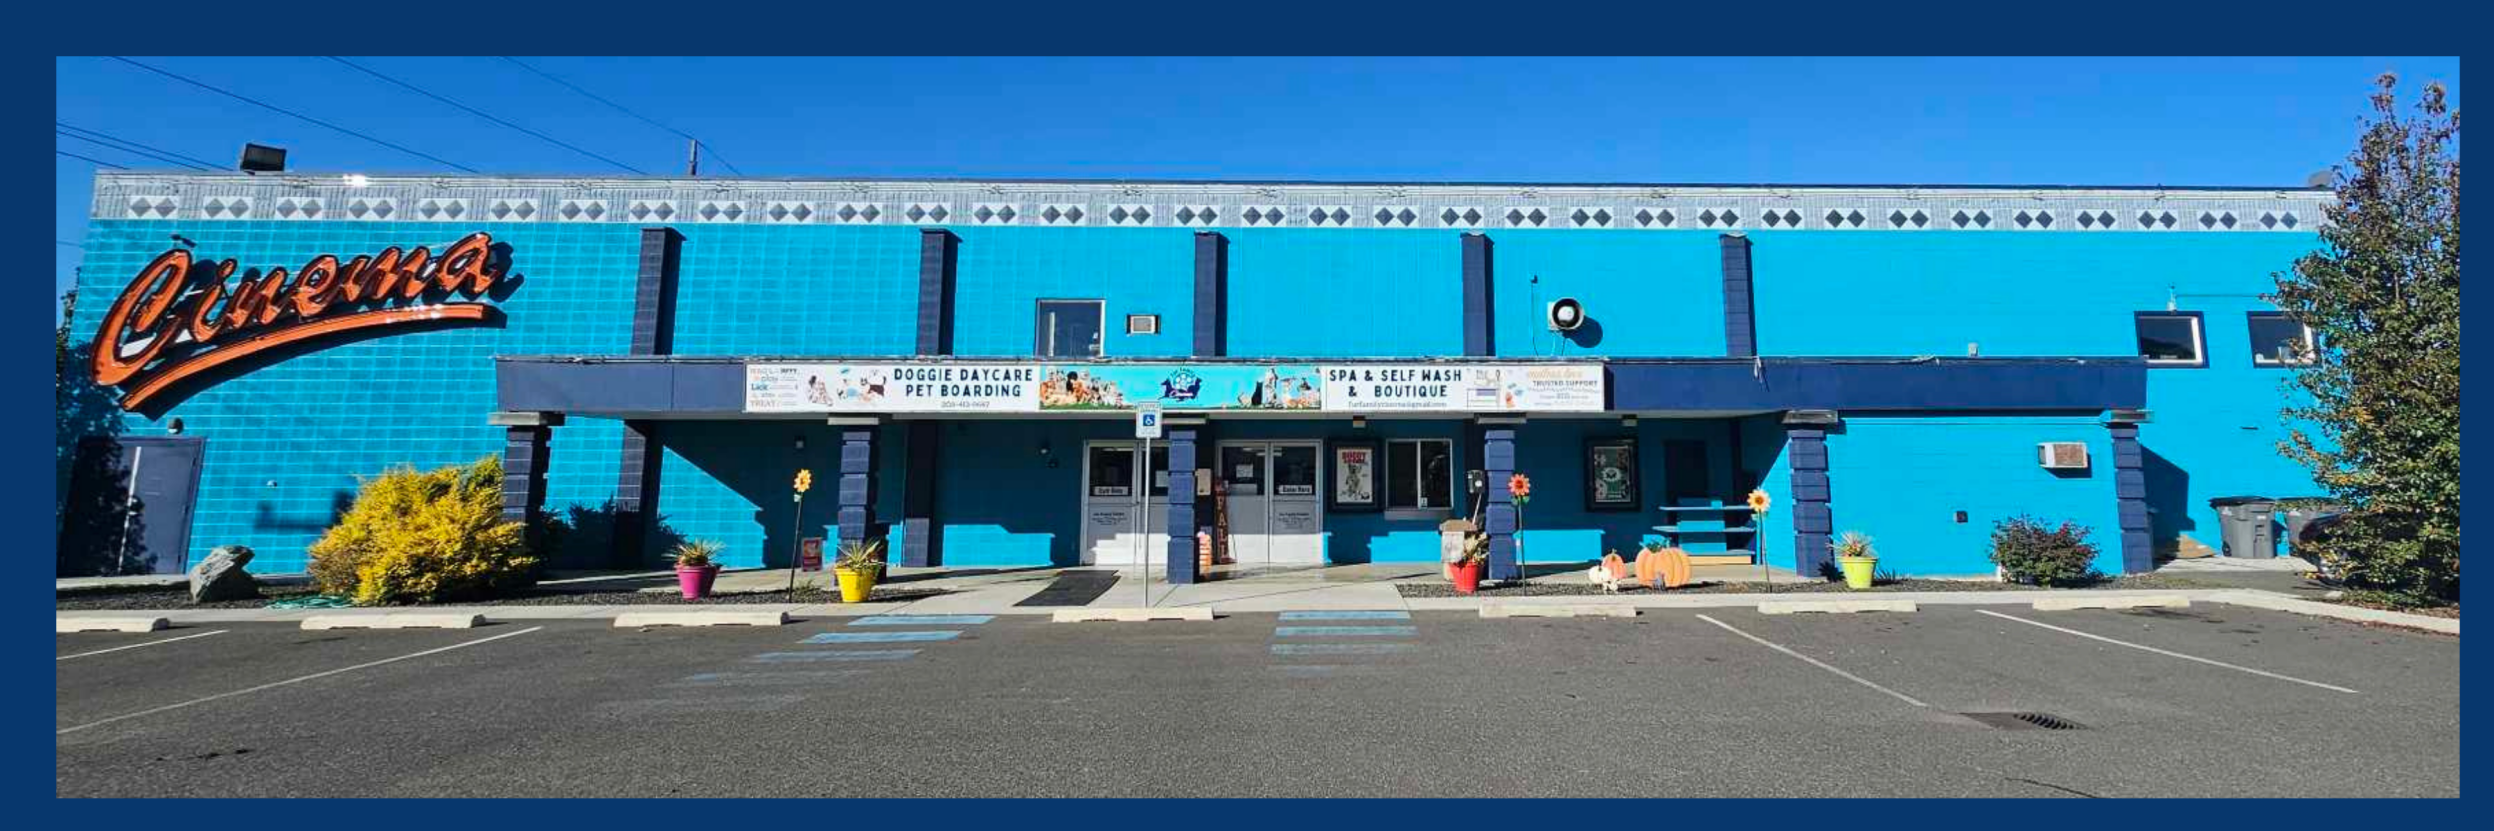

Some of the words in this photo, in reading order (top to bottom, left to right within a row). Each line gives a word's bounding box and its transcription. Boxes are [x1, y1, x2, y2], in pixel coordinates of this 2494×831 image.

[90, 231, 498, 386] Cinema
[894, 368, 953, 381] DOGGIE
[960, 368, 1033, 381] DAYCARE
[1329, 369, 1357, 382] SPA
[1364, 369, 1374, 382] &
[1381, 369, 1416, 382] SELF
[1422, 369, 1462, 382] WASH
[905, 384, 934, 397] PET
[940, 384, 1021, 397] BOARDING
[1348, 386, 1357, 397] &
[1374, 385, 1447, 398] BOUTIQUE
